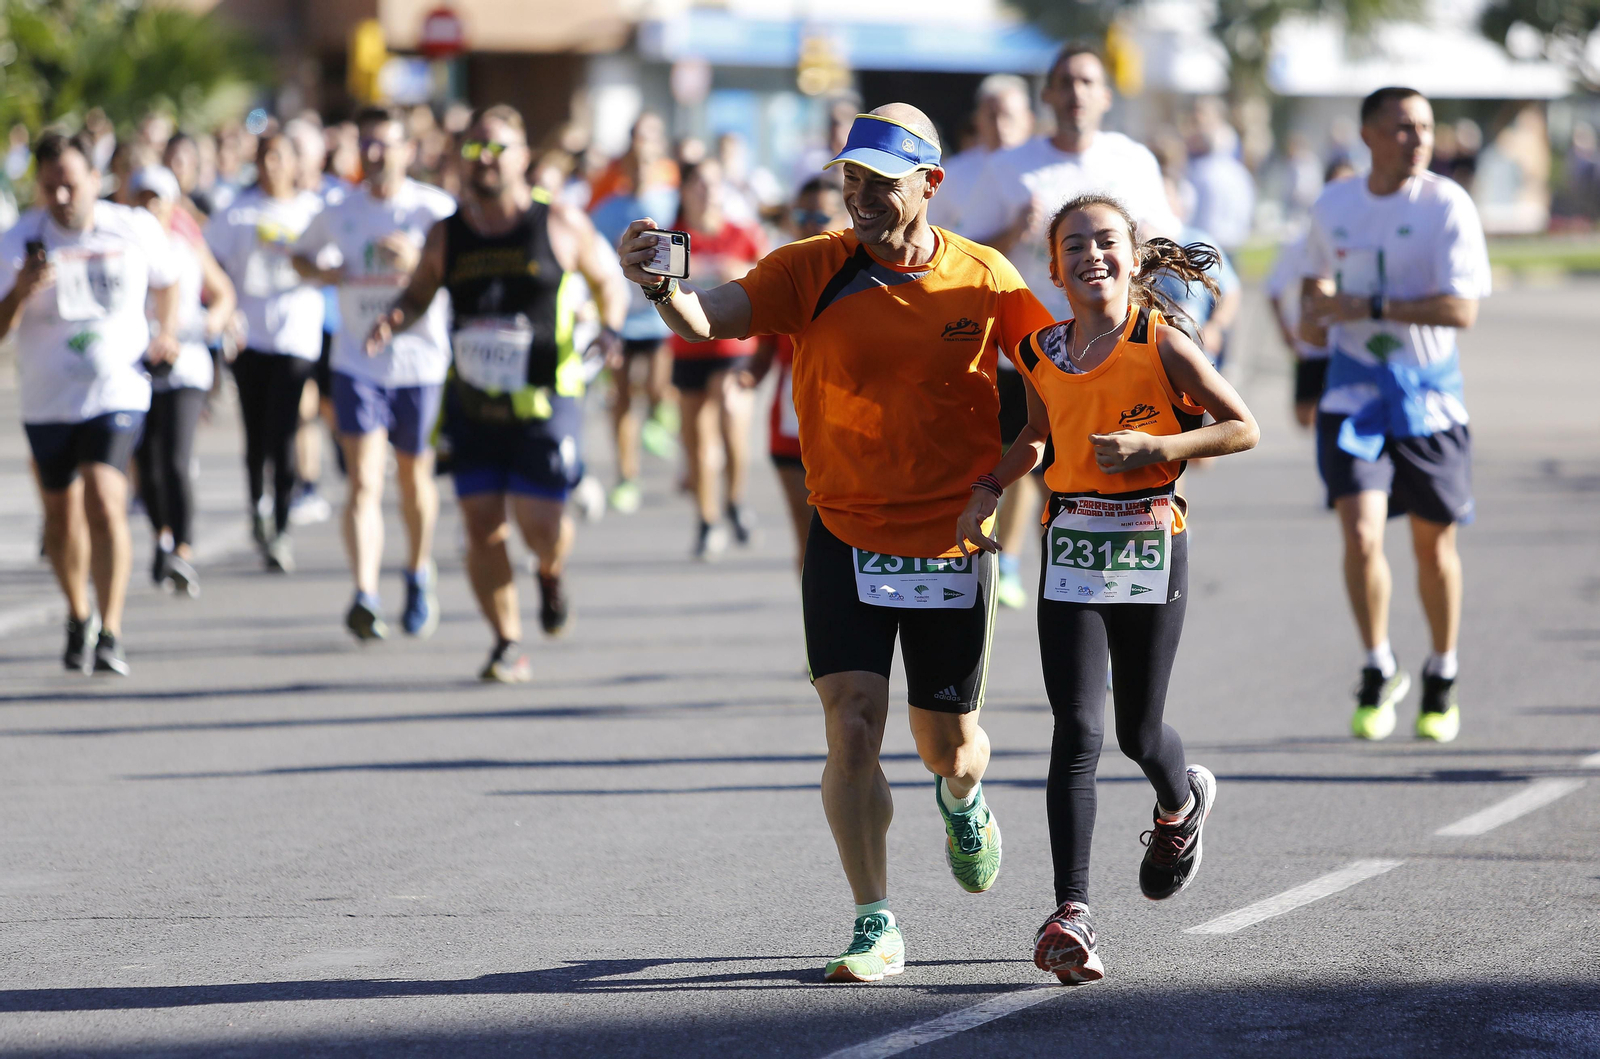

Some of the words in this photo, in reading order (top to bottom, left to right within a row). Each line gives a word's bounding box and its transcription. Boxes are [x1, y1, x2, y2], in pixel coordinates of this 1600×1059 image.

[1079, 499, 1122, 510] CARRERA
[1077, 508, 1104, 517] CIUDAD
[1105, 509, 1116, 518] DE
[1056, 537, 1161, 568] 23145
[933, 693, 961, 702] adidas
